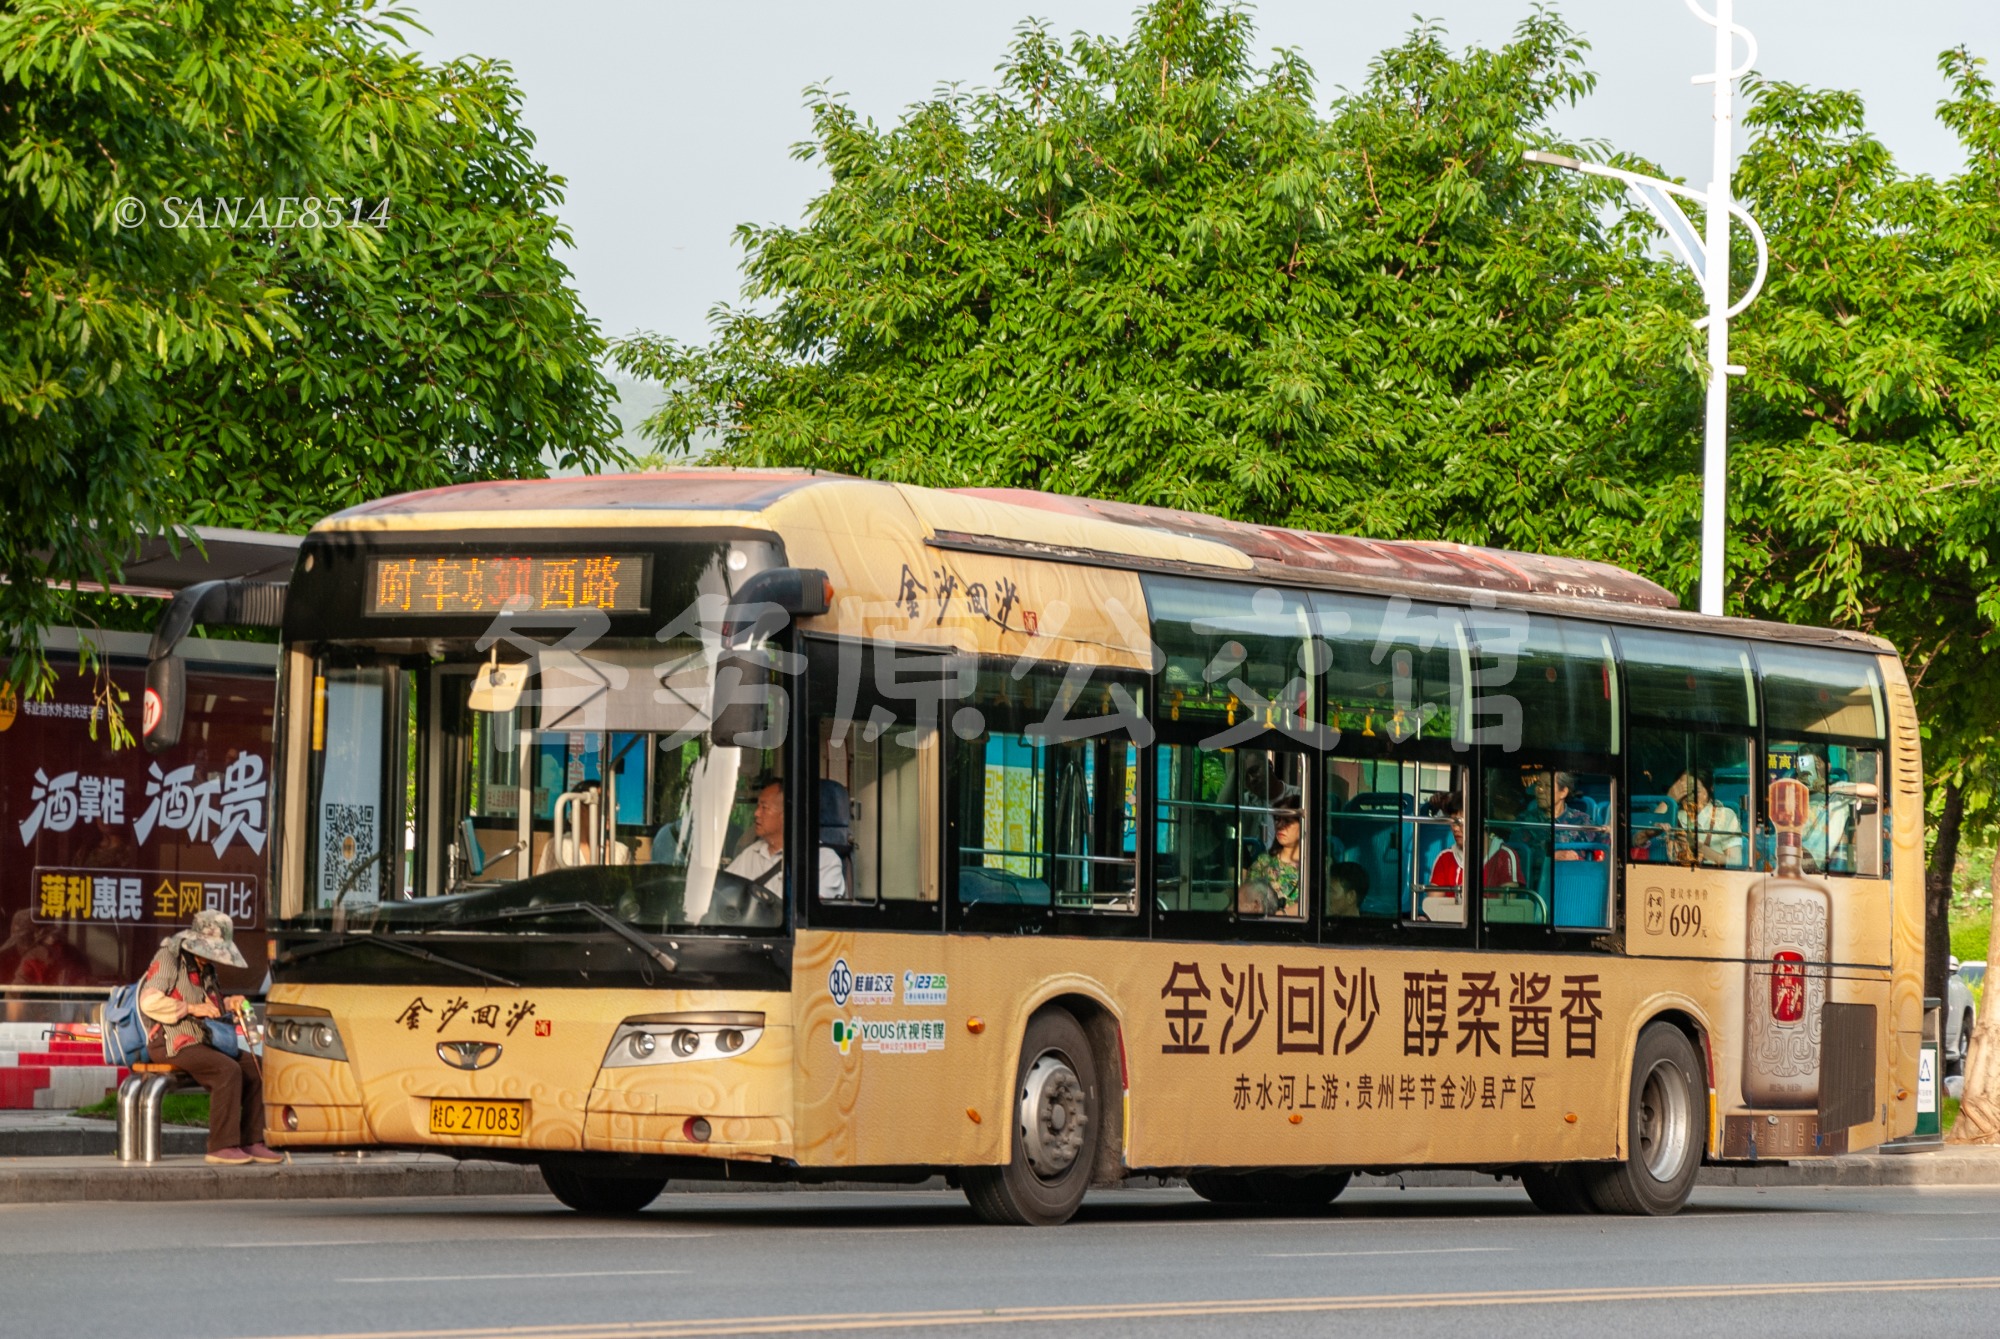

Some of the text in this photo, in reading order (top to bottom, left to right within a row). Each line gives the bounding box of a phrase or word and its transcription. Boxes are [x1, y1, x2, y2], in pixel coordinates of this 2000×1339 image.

[19, 751, 268, 860] 酒掌柜 酒不贵
[40, 874, 253, 921] 薄利惠民 全网可比
[854, 975, 895, 993] 桂林公交
[1161, 961, 1603, 1059] 金沙回沙 醇柔酱香
